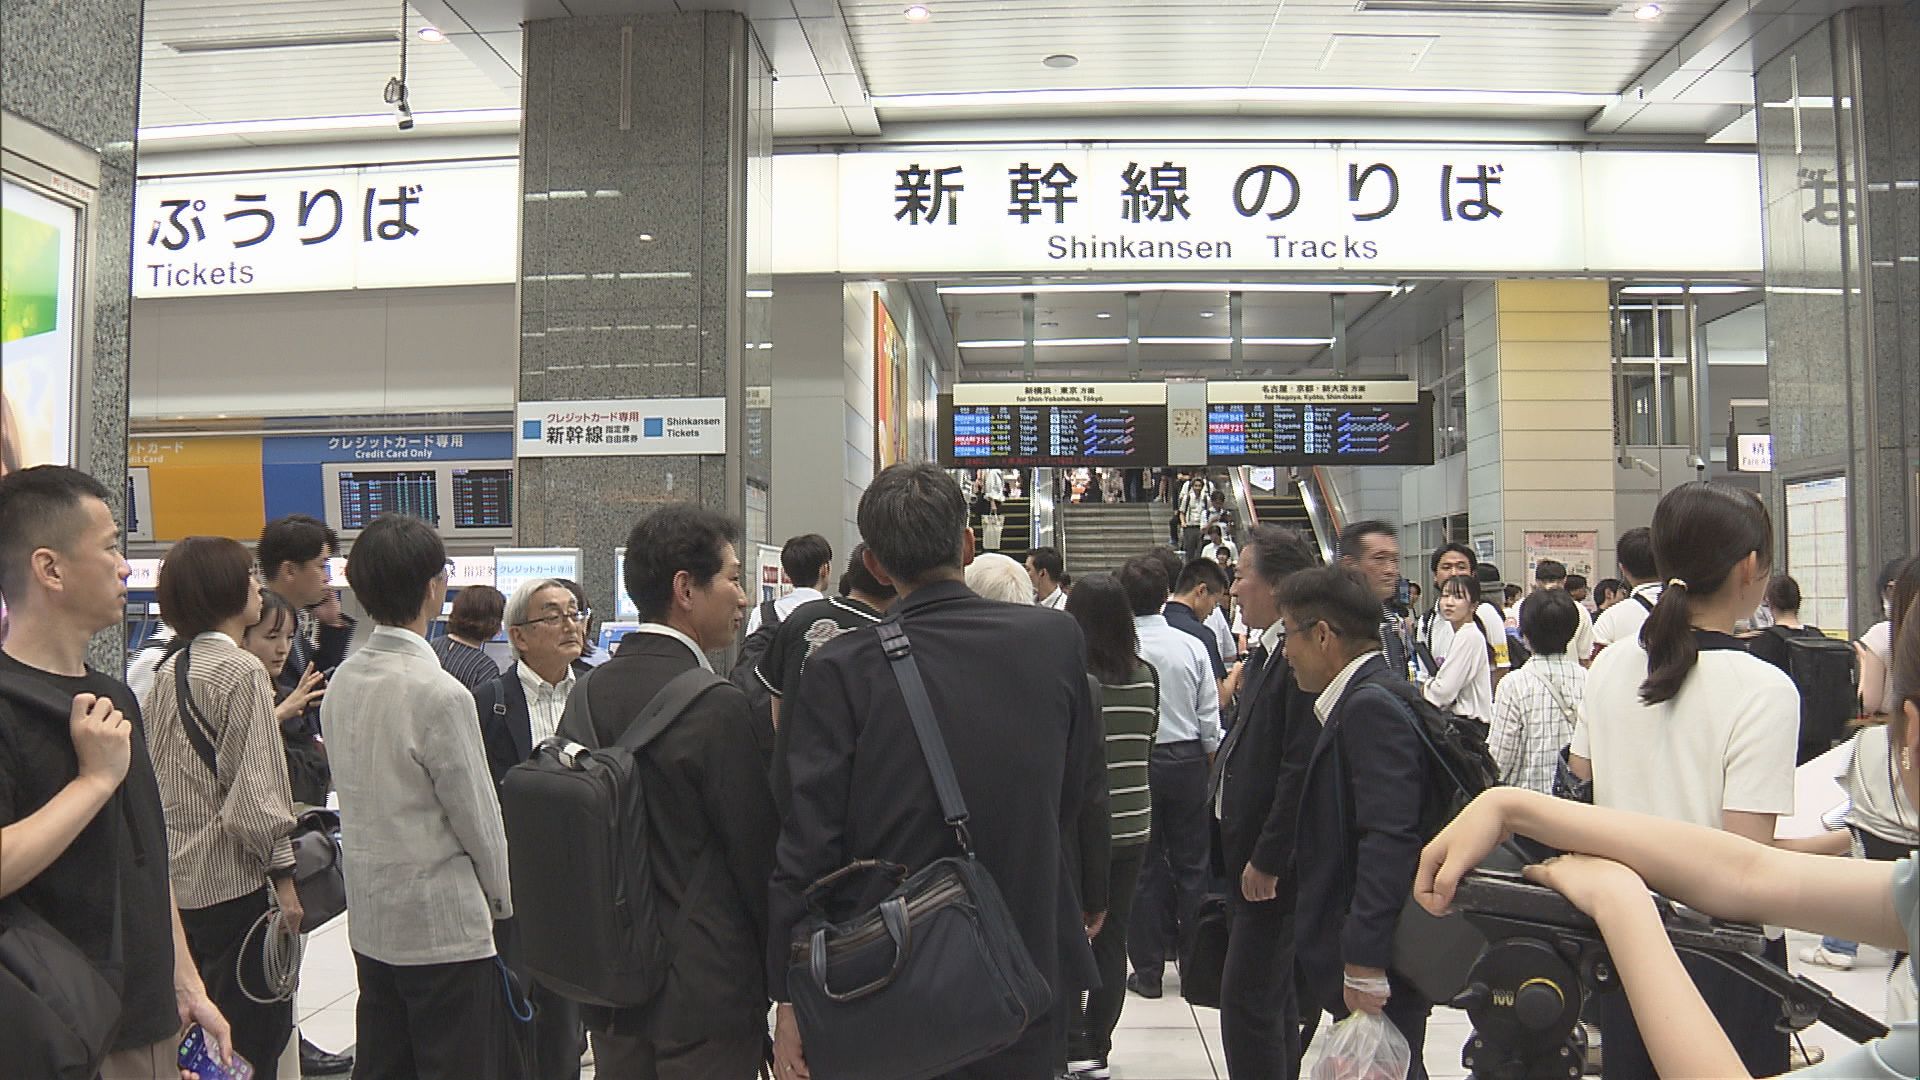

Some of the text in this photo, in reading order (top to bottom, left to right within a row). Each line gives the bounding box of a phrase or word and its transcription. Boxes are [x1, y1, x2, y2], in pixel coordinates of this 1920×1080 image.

[895, 161, 1504, 226] 新幹線のりば
[147, 184, 423, 251] ぷうりば
[1049, 235, 1378, 260] Shinkansen Tracks
[147, 262, 254, 287] Tickets
[547, 411, 640, 423] クレジットカード専用
[667, 417, 721, 426] Shinkansen
[547, 425, 604, 444] 新幹線
[605, 425, 631, 434] 指定券
[667, 429, 700, 438] Tickets
[328, 434, 464, 450] クレジットカード専用
[355, 448, 433, 459] Credit Card Only
